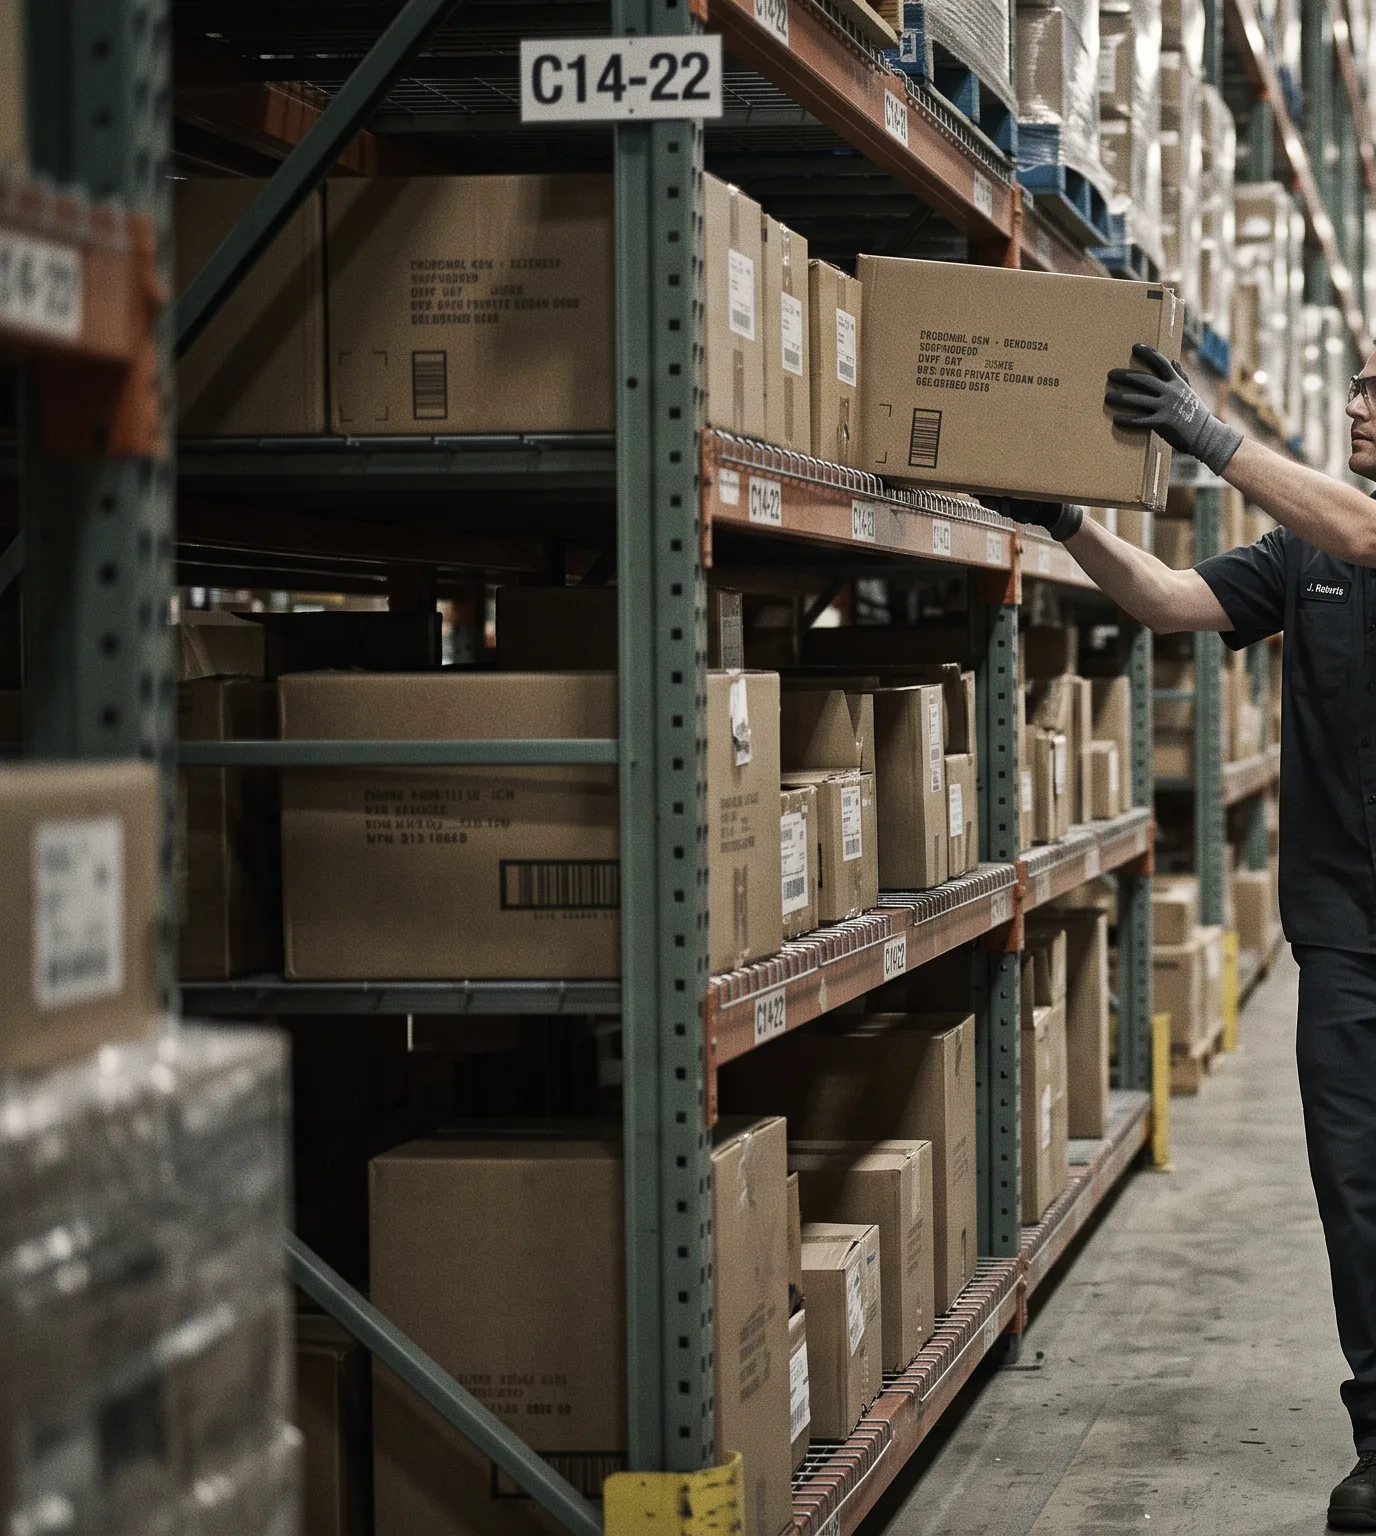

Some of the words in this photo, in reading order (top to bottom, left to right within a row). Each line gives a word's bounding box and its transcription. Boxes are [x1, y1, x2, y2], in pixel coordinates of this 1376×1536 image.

[532, 51, 710, 104] C14-22
[964, 369, 1001, 382] PRIVATE
[1306, 582, 1314, 592] J.
